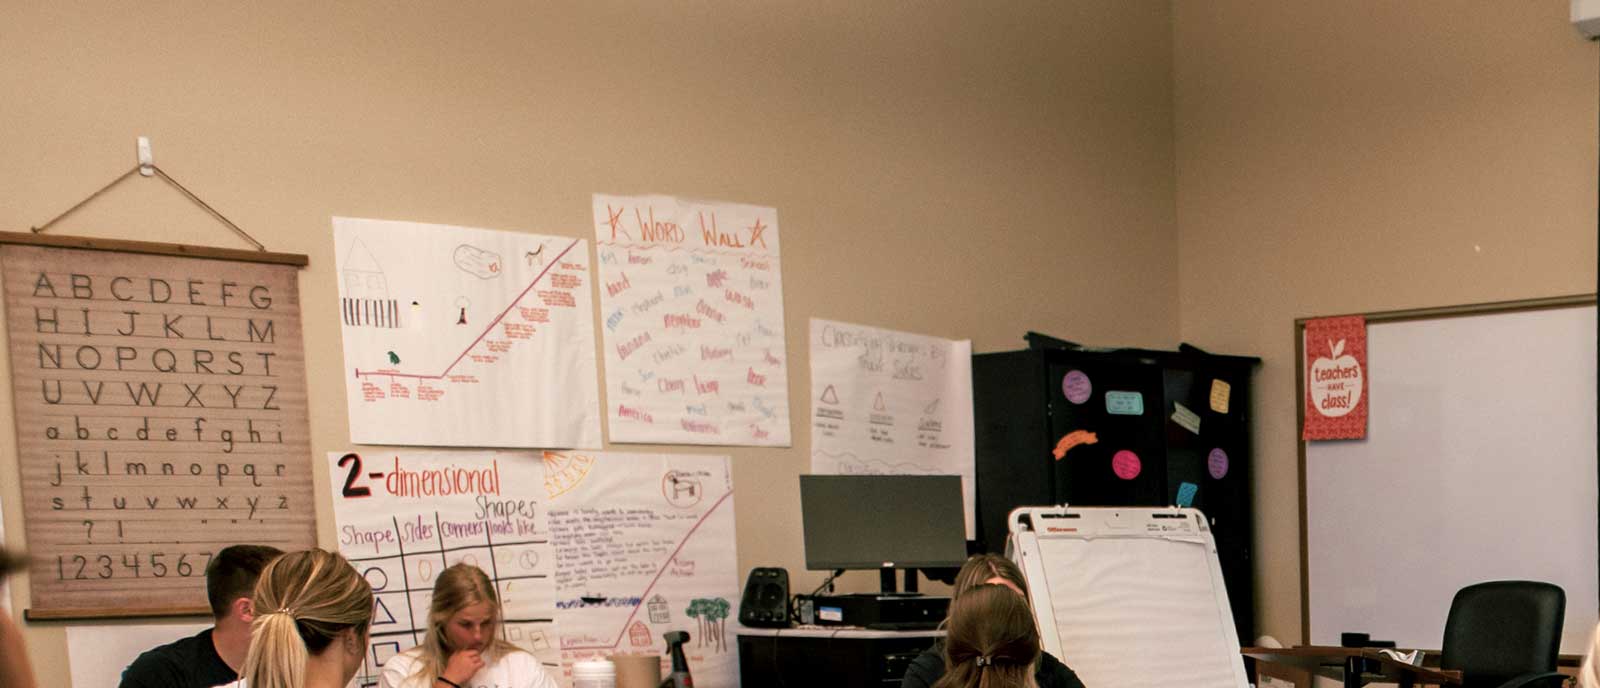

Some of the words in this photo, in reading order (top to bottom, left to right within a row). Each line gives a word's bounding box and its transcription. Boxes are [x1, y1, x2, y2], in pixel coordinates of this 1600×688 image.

[1314, 365, 1358, 382] teachers
[1327, 382, 1345, 391] HAVE
[1321, 389, 1352, 410] class!
[337, 453, 501, 499] 2-dimensional
[475, 495, 537, 521] Shapes
[442, 520, 484, 538] corners
[489, 518, 514, 536] looks
[341, 525, 395, 554] Shape
